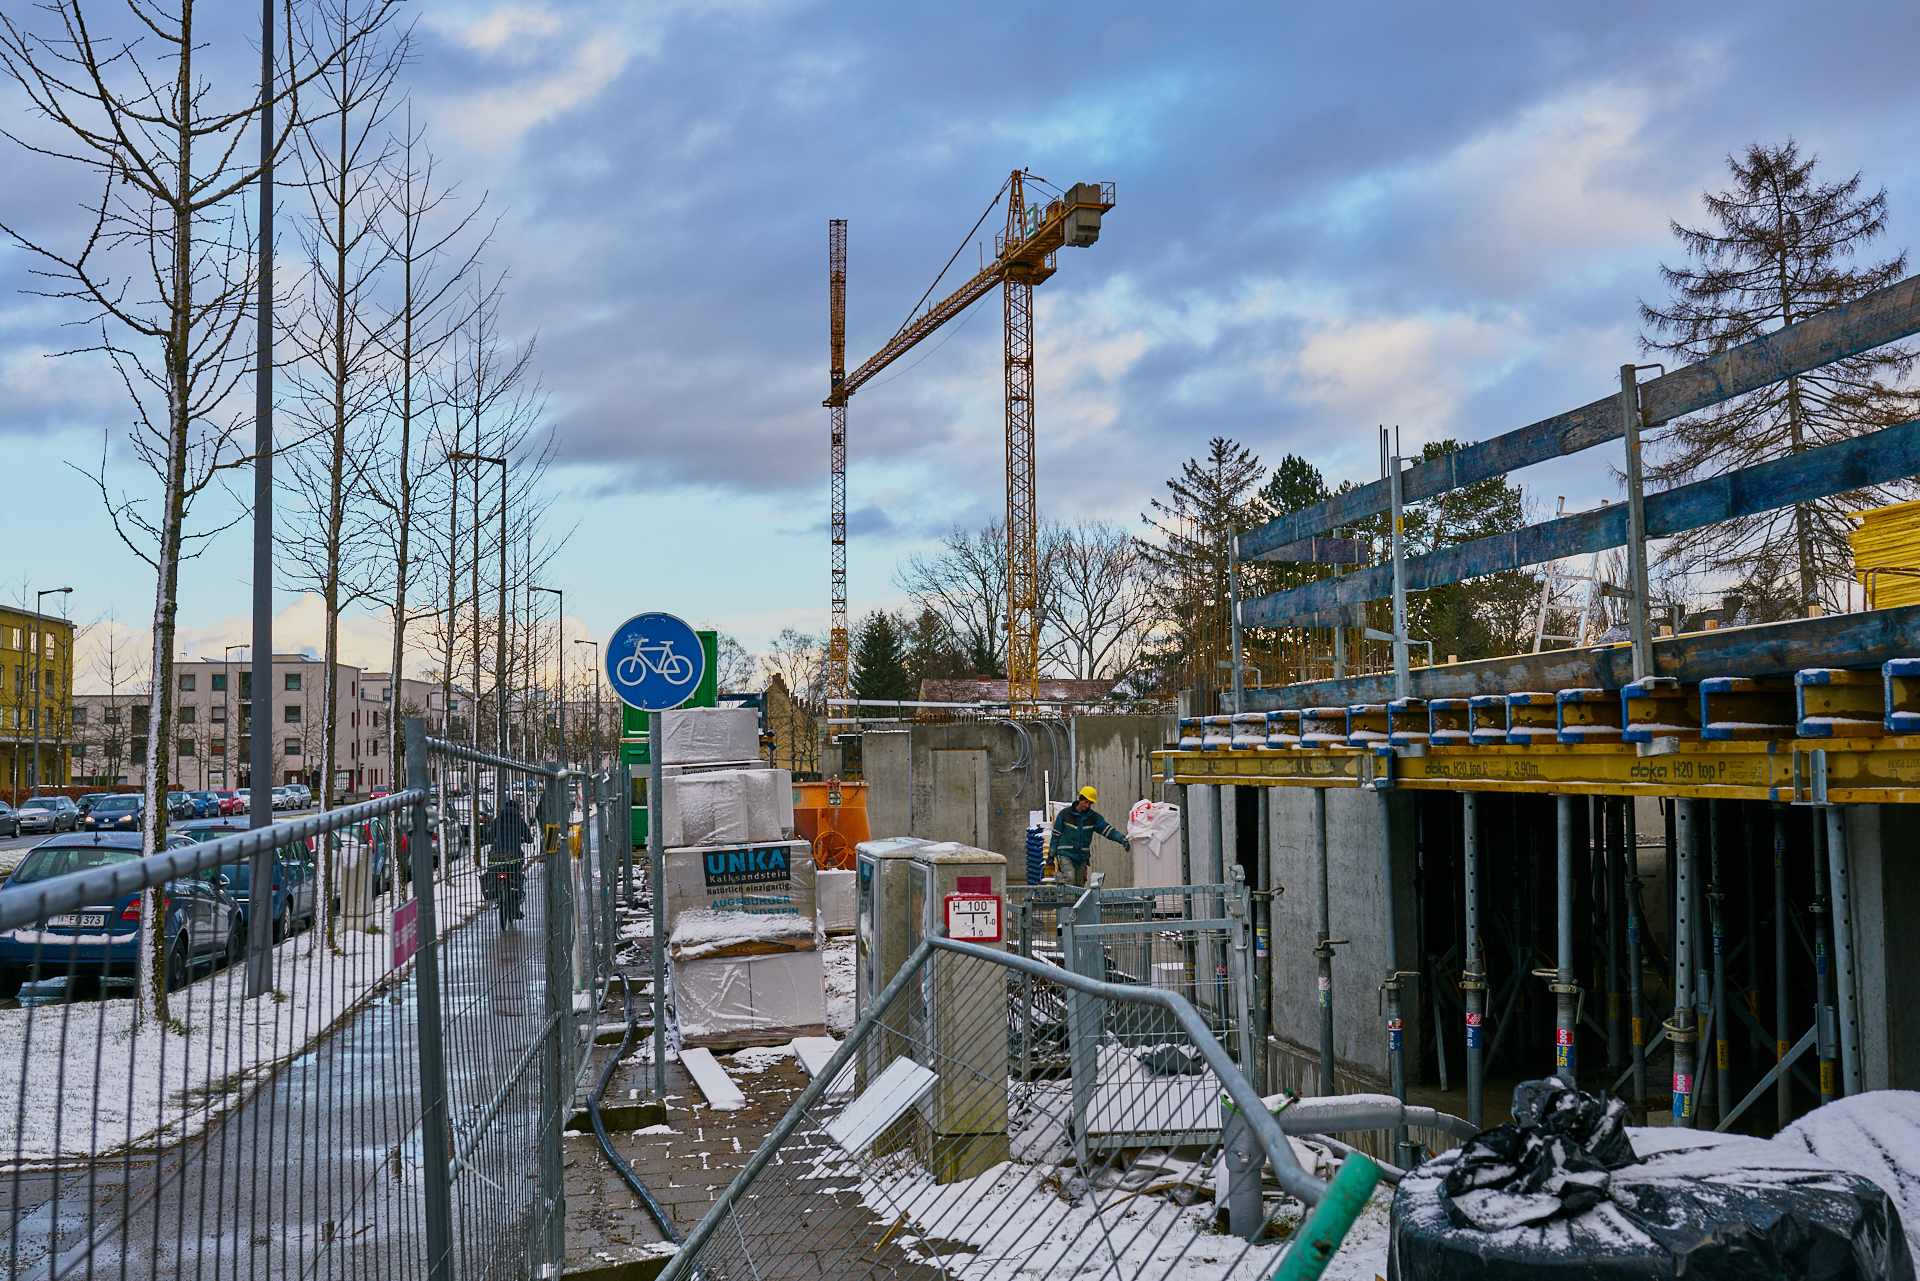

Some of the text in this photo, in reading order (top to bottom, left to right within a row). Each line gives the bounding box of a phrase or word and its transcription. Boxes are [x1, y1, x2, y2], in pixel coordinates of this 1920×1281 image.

[1425, 761, 1450, 775] doka
[1453, 761, 1467, 775] H20
[1470, 761, 1480, 778] top
[1483, 761, 1488, 775] P
[1514, 761, 1539, 776] 3.90m
[1630, 761, 1667, 778] doka
[1673, 761, 1693, 779] H20
[1698, 761, 1715, 782] top
[1718, 761, 1725, 779] P
[709, 870, 787, 883] Kalksandstein
[706, 882, 792, 895] Natürlich einzigartig.
[711, 896, 791, 909] AUGSBURGER
[953, 901, 987, 911] H 100
[83, 915, 101, 924] 373
[1467, 1038, 1474, 1047] 20
[1560, 1029, 1568, 1044] 300
[1560, 1056, 1568, 1067] 20
[1677, 1074, 1686, 1091] 300
[1681, 1095, 1690, 1118] Eurex
